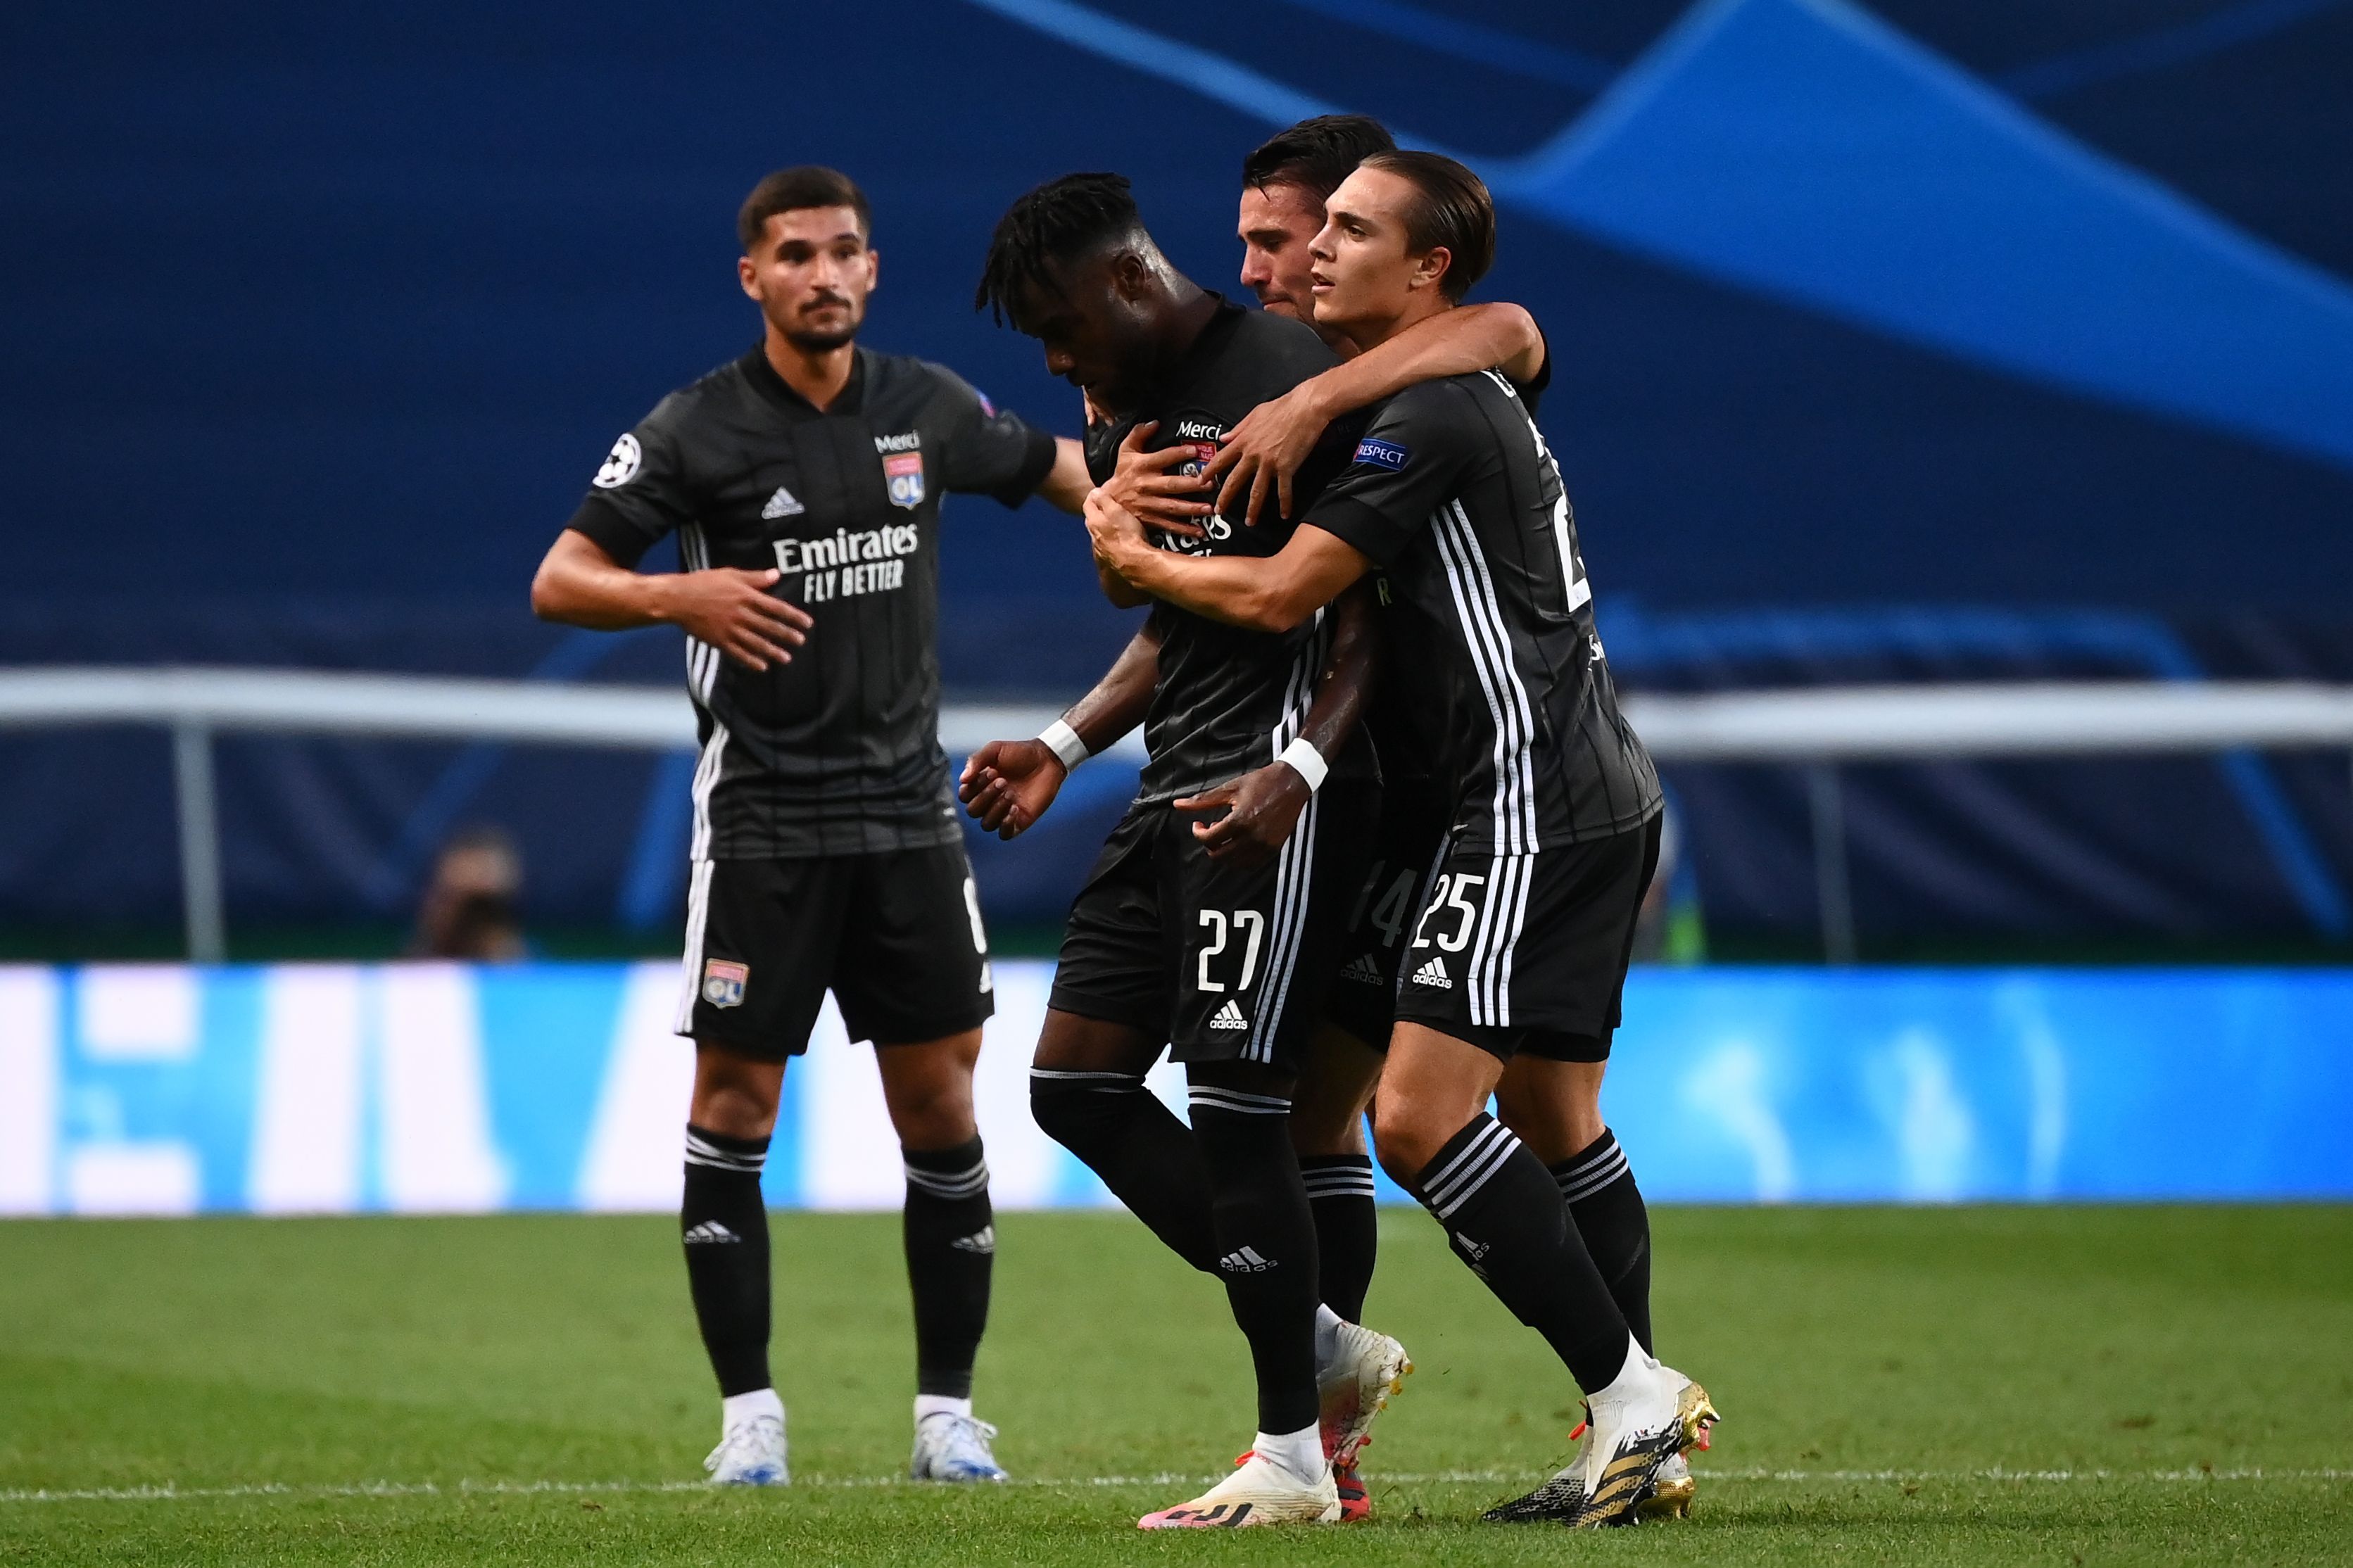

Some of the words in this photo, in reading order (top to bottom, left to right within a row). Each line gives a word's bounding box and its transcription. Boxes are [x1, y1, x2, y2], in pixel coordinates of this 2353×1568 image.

[1175, 421, 1223, 441] Merci
[1358, 445, 1405, 464] RESPECT
[772, 524, 919, 574] Emirates
[804, 570, 837, 604] FLY
[842, 559, 904, 597] BETTER
[1411, 873, 1485, 952] 25
[1198, 909, 1265, 992] 27
[1412, 972, 1453, 989] adidas
[1209, 1018, 1248, 1030] adidas
